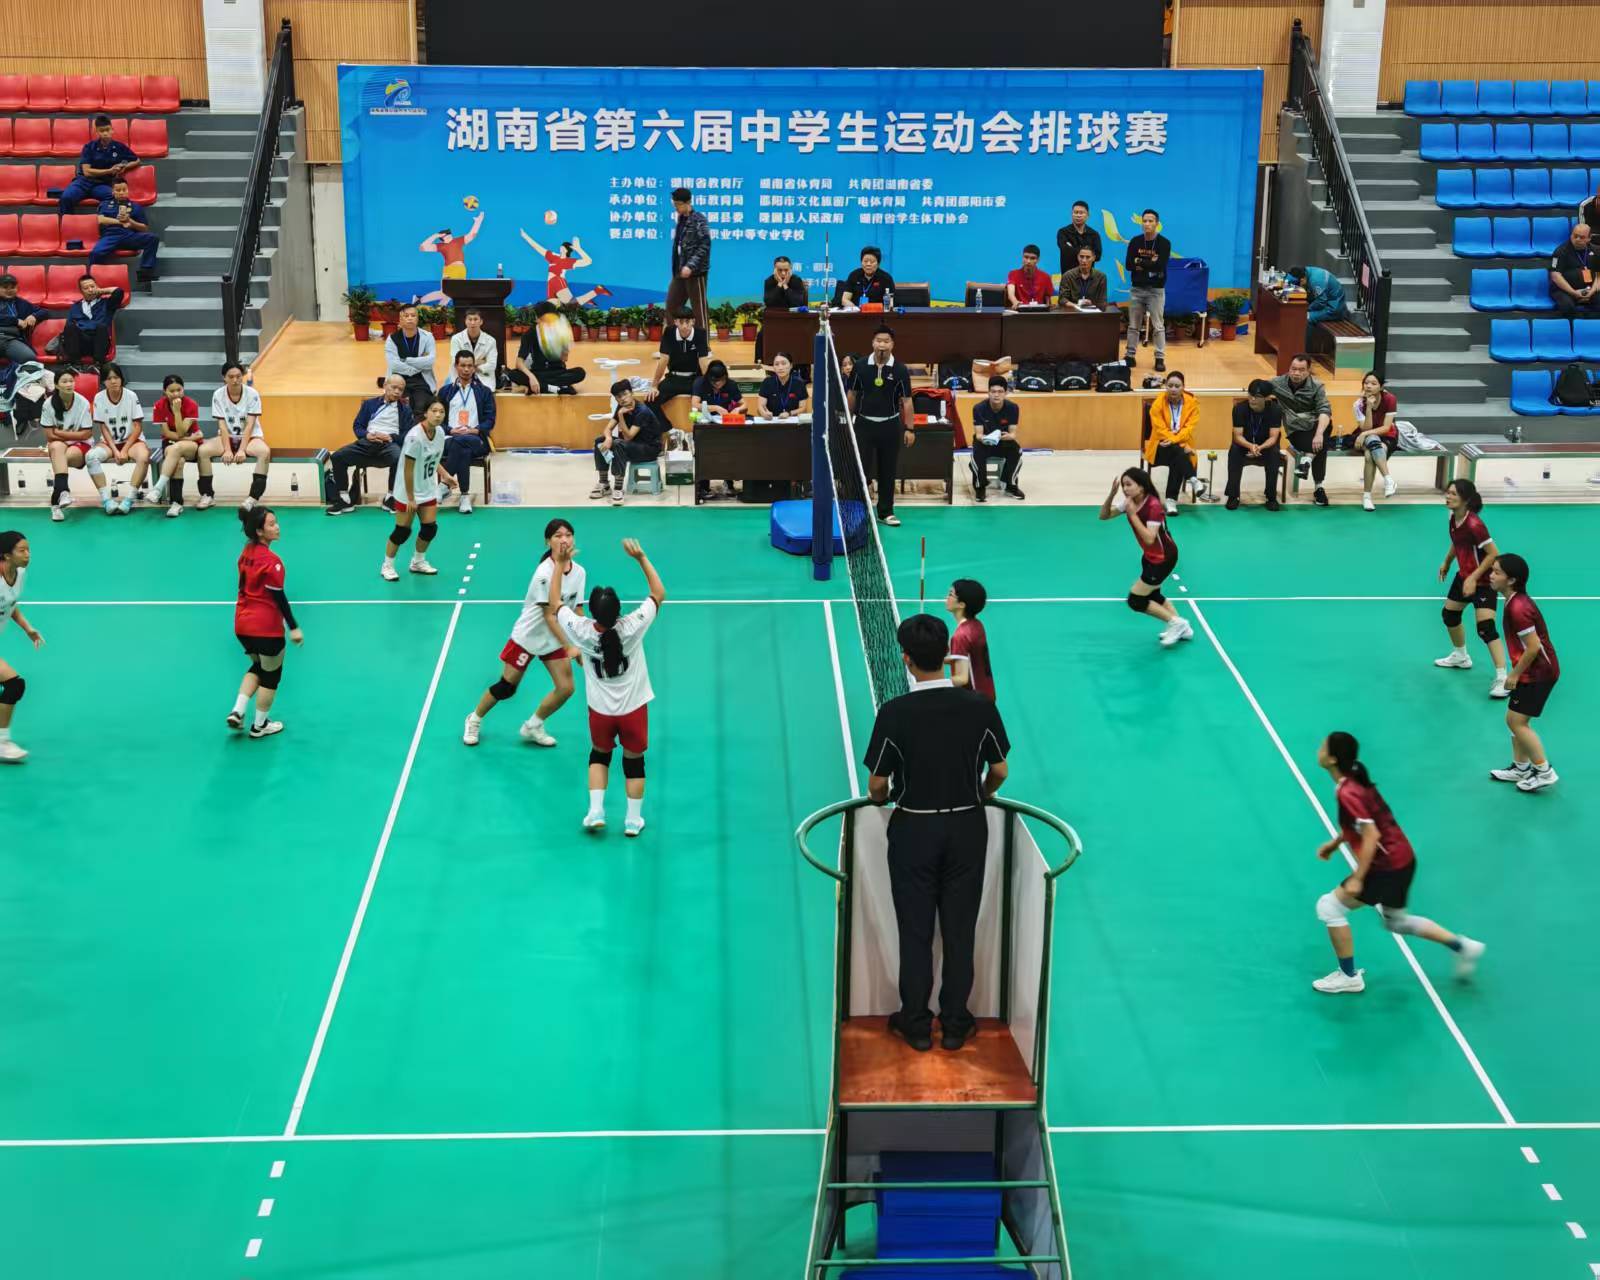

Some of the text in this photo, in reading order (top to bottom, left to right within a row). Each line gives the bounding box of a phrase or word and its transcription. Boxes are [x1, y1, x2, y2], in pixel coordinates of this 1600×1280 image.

[446, 107, 1169, 156] 湖南省第六届中学生运动会排球赛
[112, 426, 126, 442] 12
[423, 461, 436, 480] 16
[516, 652, 529, 667] 9
